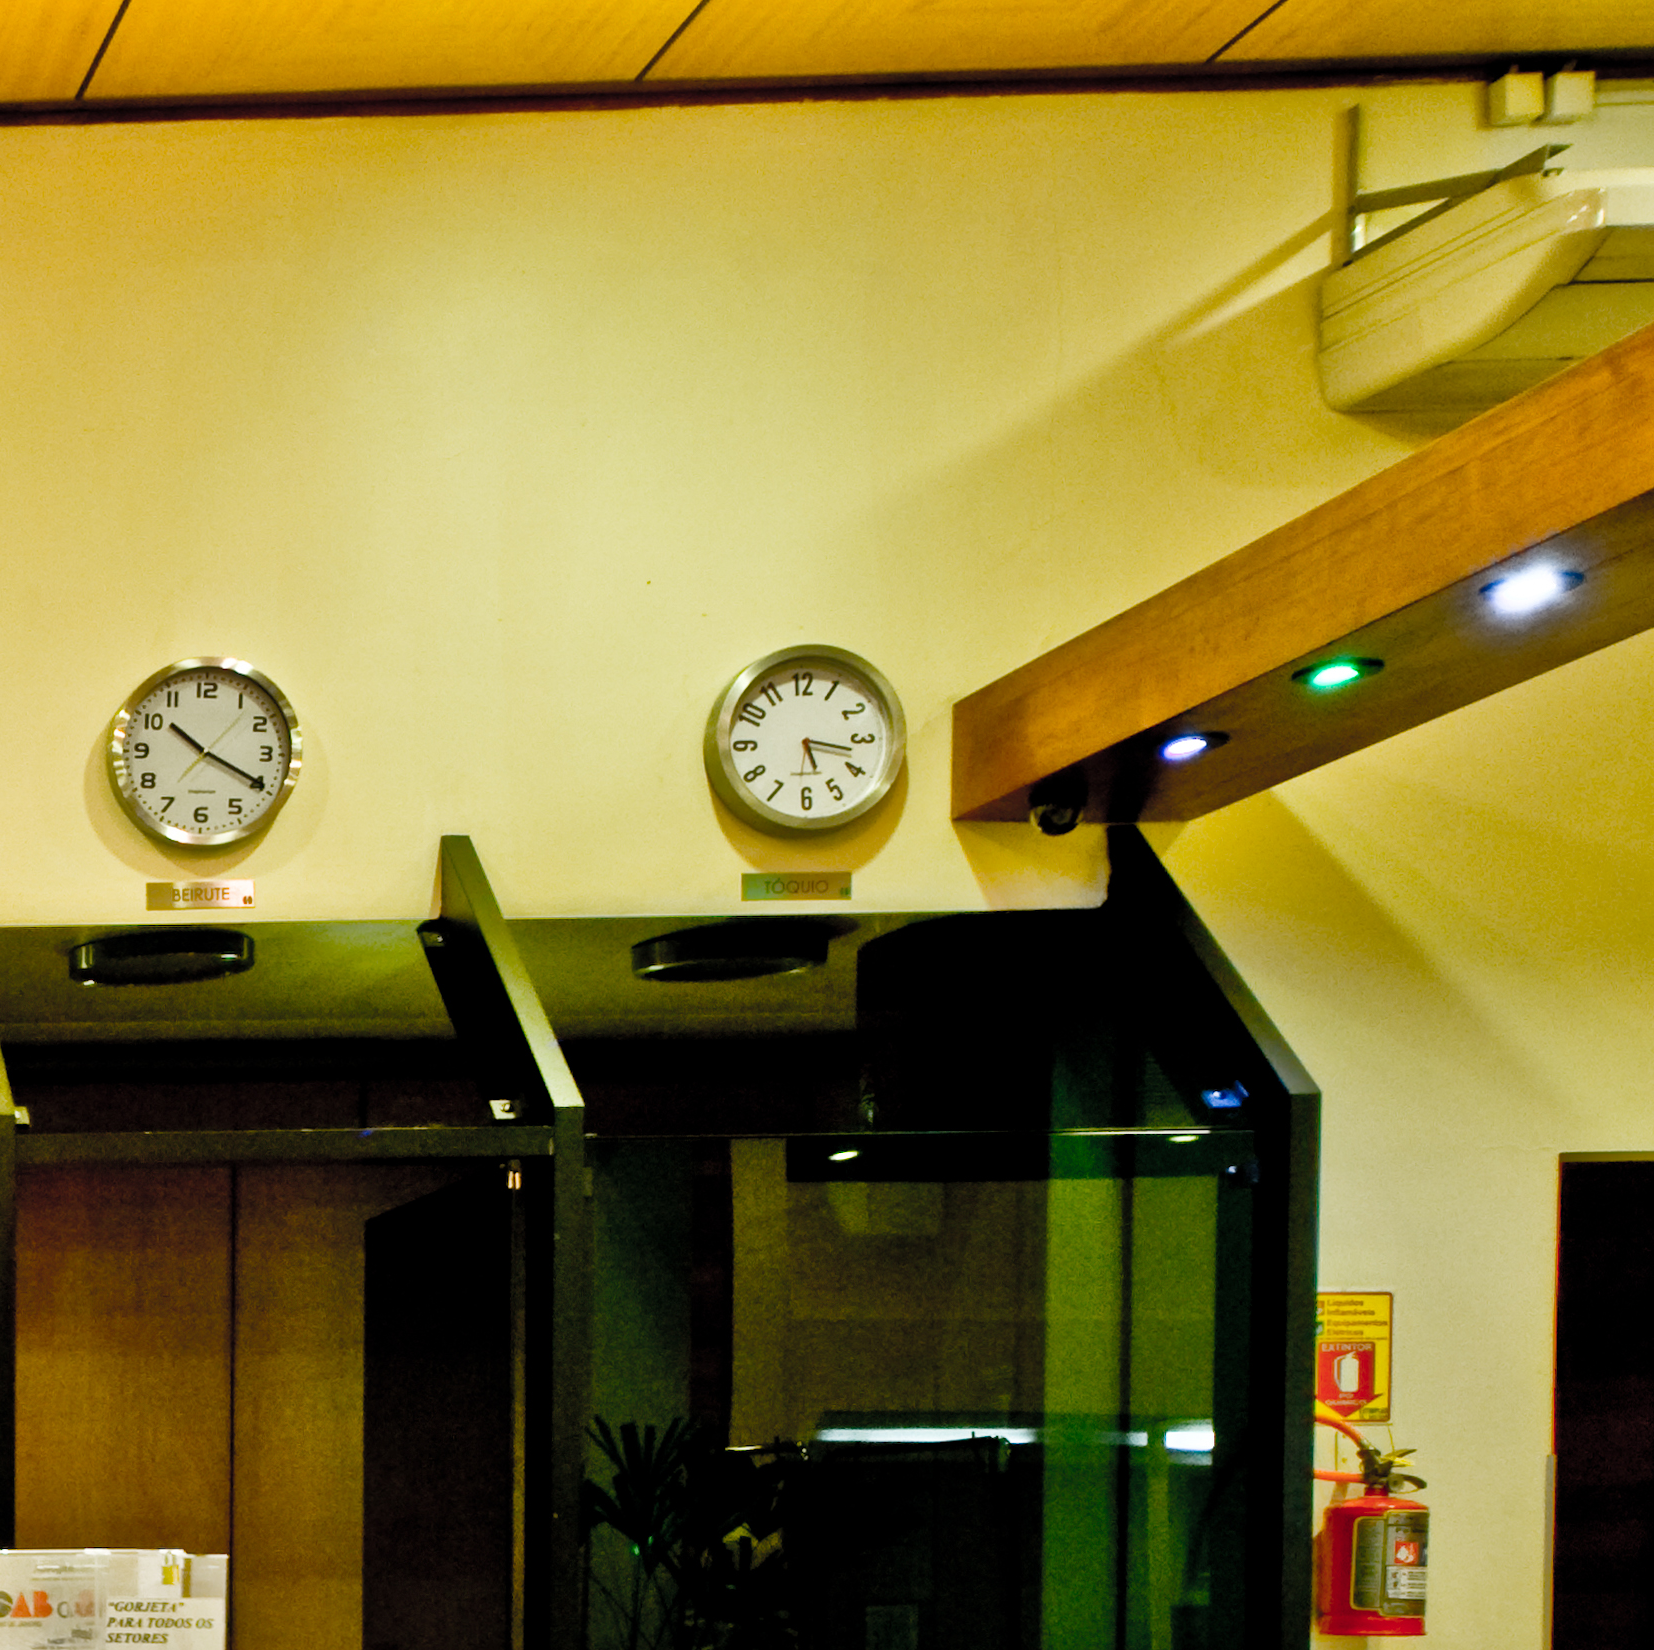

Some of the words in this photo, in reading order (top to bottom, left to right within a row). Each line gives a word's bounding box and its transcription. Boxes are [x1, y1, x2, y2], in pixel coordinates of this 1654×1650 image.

[196, 683, 218, 698] 12
[792, 672, 813, 696] 12
[825, 680, 840, 700] 1
[167, 691, 178, 707] 11
[238, 693, 243, 709] 1
[760, 681, 783, 706] 11
[739, 703, 766, 726] 10
[842, 703, 866, 720] 2
[145, 714, 163, 730] 10
[253, 717, 267, 732] 2
[733, 740, 758, 751] 9
[851, 733, 875, 744] 3
[134, 743, 149, 759] 9
[259, 746, 273, 761] 3
[744, 765, 766, 783] 8
[845, 762, 866, 777] 4
[140, 773, 156, 789] 8
[767, 780, 784, 801] 7
[826, 778, 843, 801] 5
[161, 797, 175, 813] 7
[228, 799, 242, 814] 5
[801, 787, 812, 810] 6
[193, 807, 208, 823] 6
[172, 888, 230, 902] BEIRUTE
[765, 880, 828, 894] TÓQUIO
[107, 1617, 142, 1627] PARA
[148, 1618, 193, 1628] TODOS
[196, 1619, 214, 1629] OS
[105, 1633, 169, 1643] SETORES
